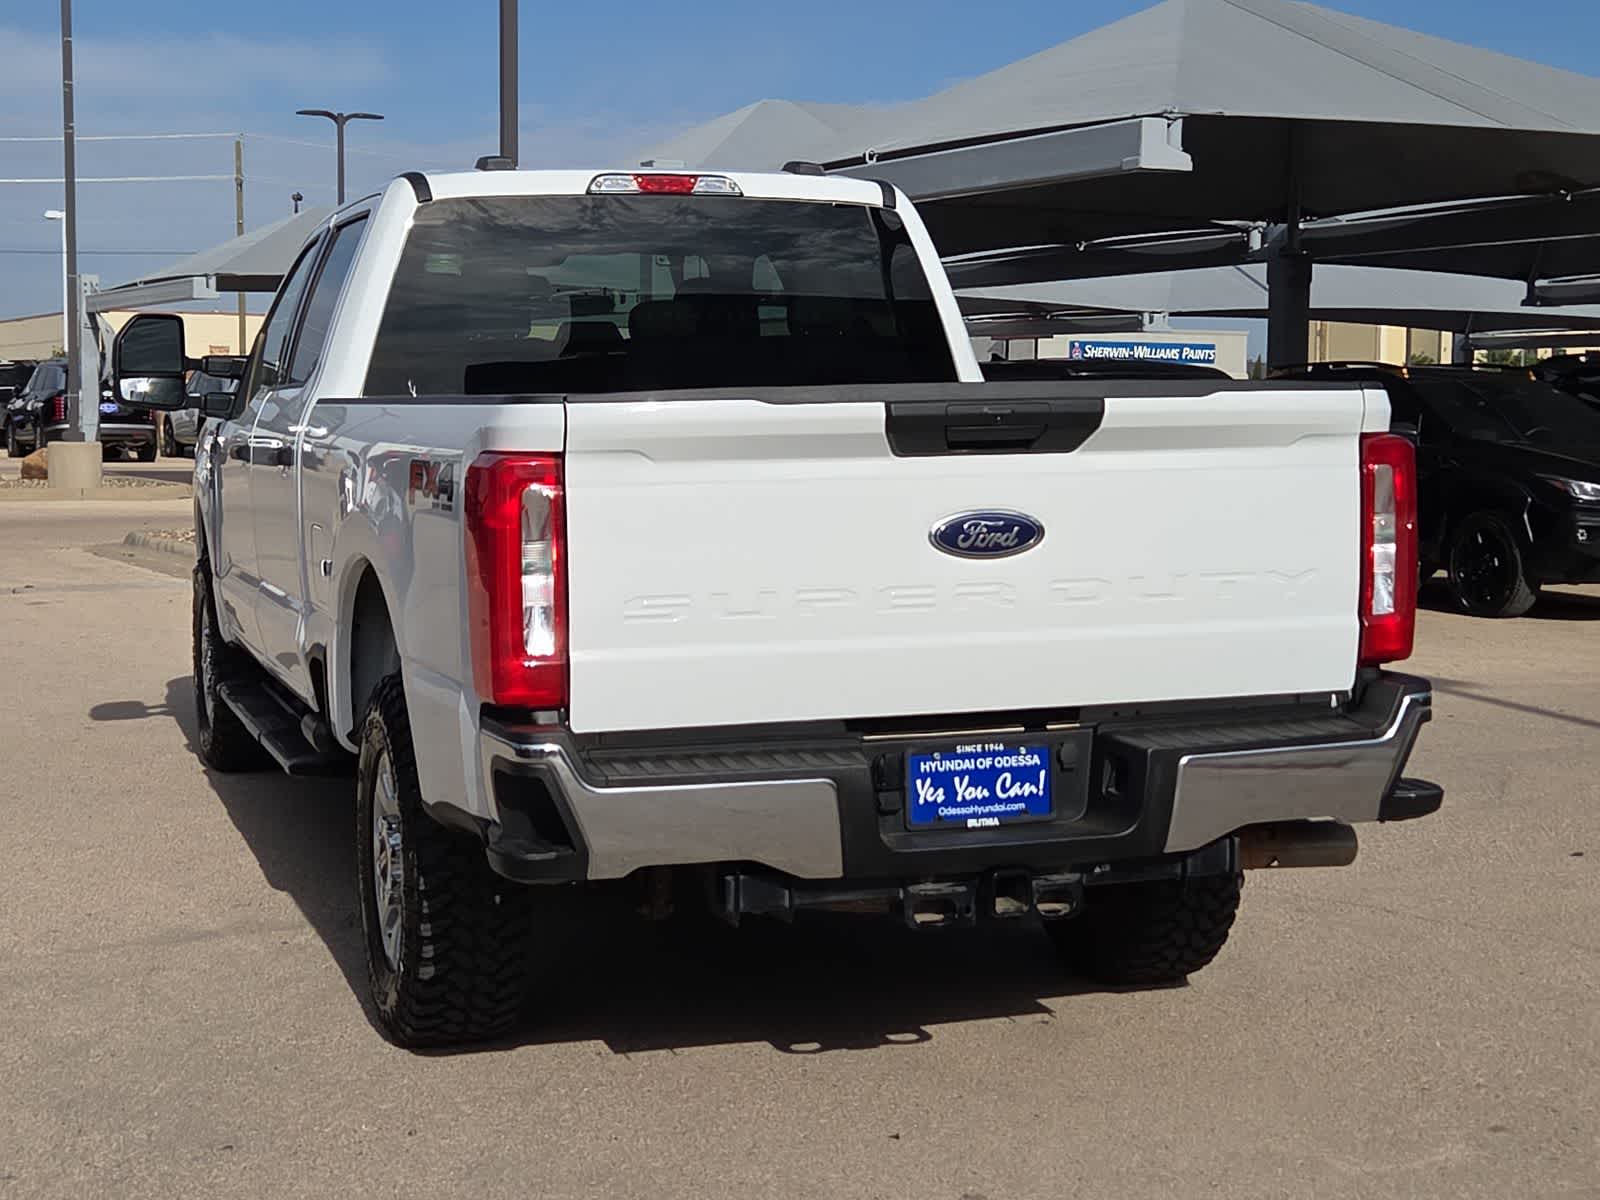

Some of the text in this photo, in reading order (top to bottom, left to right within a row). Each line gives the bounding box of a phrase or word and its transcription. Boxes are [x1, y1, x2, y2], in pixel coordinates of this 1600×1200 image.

[1083, 344, 1216, 360] SHERWIN-WILLIAMS PAINTS
[409, 459, 454, 505] FX4
[958, 519, 1020, 548] Ford
[623, 567, 1320, 624] SUPER DUTY
[955, 744, 982, 755] SINCE
[919, 754, 1041, 774] HYUNDAI OF ODESSA
[915, 769, 1046, 805] Yes You Can!
[938, 802, 1026, 817] OdessaHyundai.com
